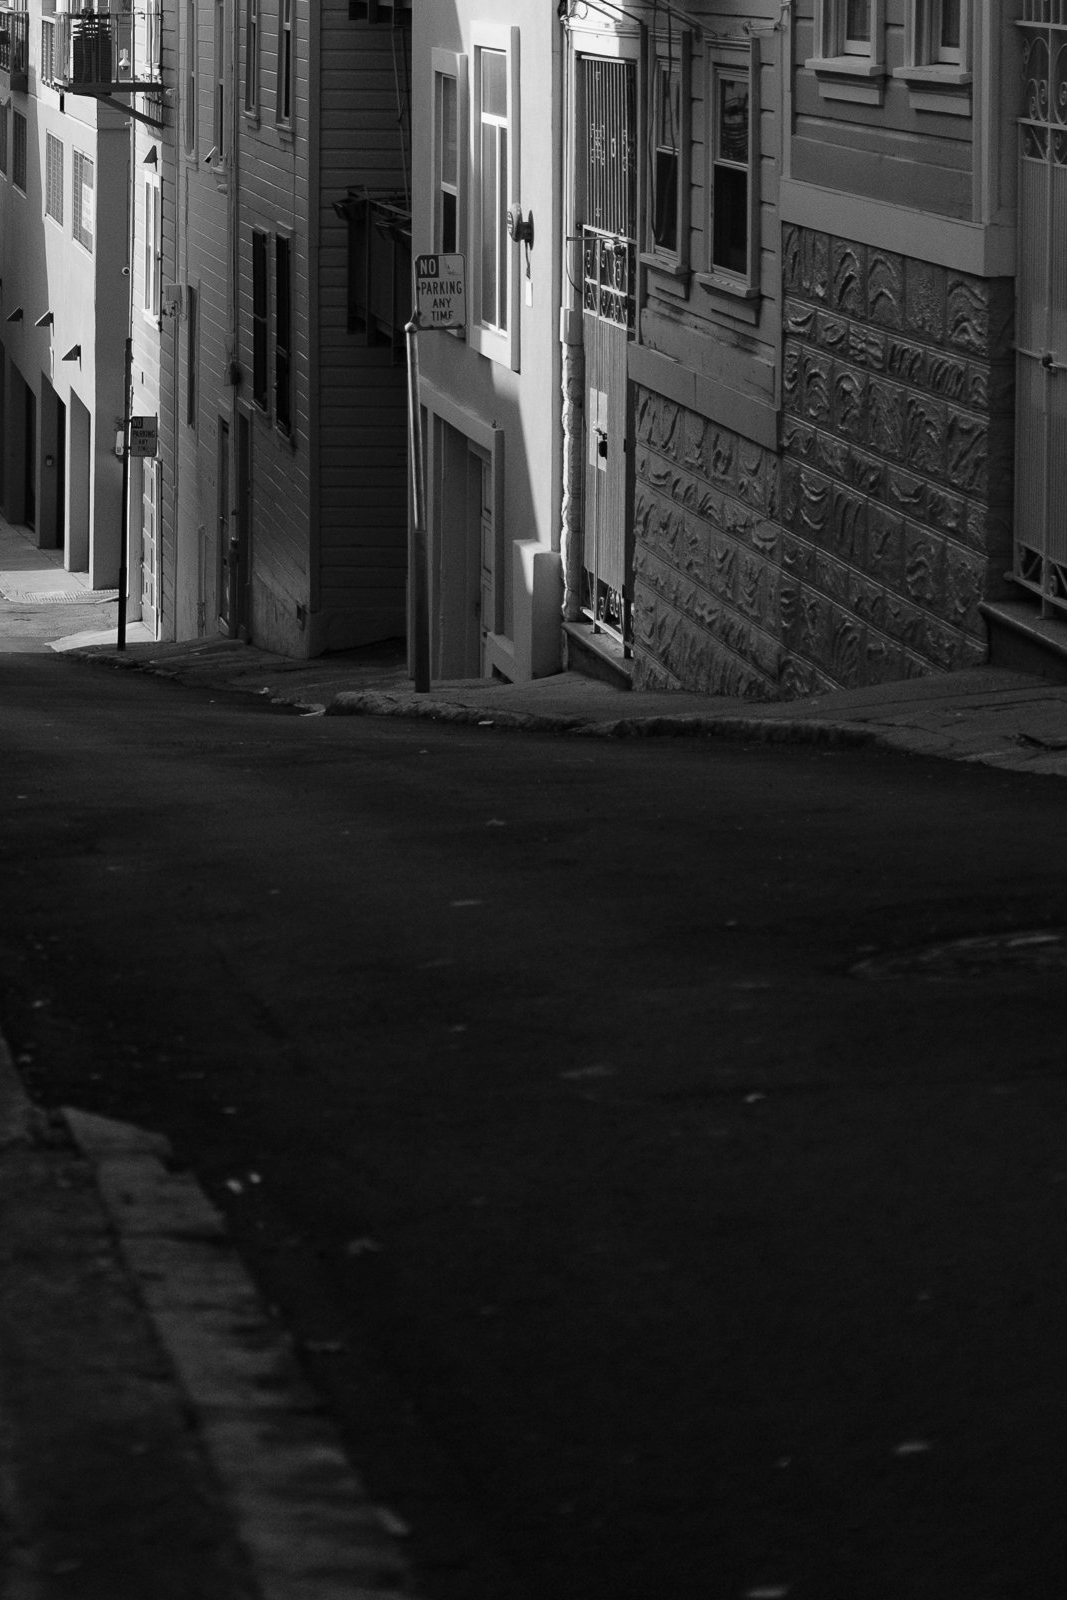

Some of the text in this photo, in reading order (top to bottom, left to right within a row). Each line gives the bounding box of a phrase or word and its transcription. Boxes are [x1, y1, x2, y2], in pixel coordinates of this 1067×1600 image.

[420, 258, 437, 275] NO
[421, 280, 462, 296] PARKING
[432, 297, 452, 309] ANY
